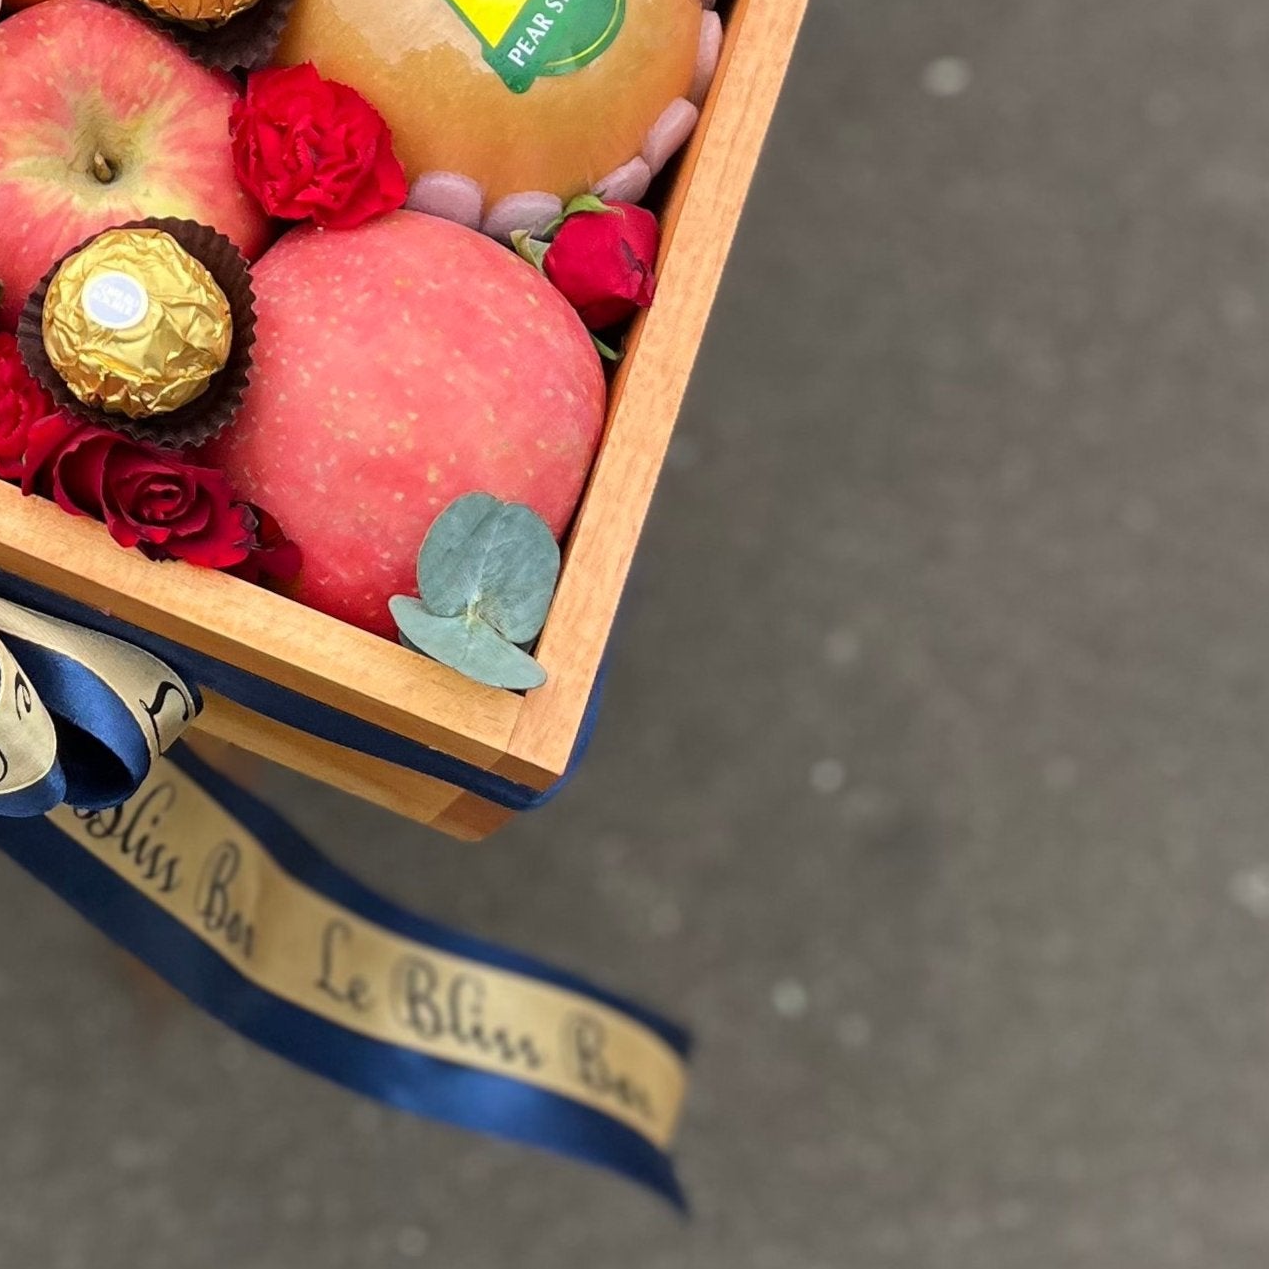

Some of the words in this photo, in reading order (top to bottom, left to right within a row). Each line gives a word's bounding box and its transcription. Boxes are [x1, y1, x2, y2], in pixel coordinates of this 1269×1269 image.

[507, 13, 554, 67] PEAR
[315, 920, 372, 1011] Le
[389, 953, 543, 1070] Bliss
